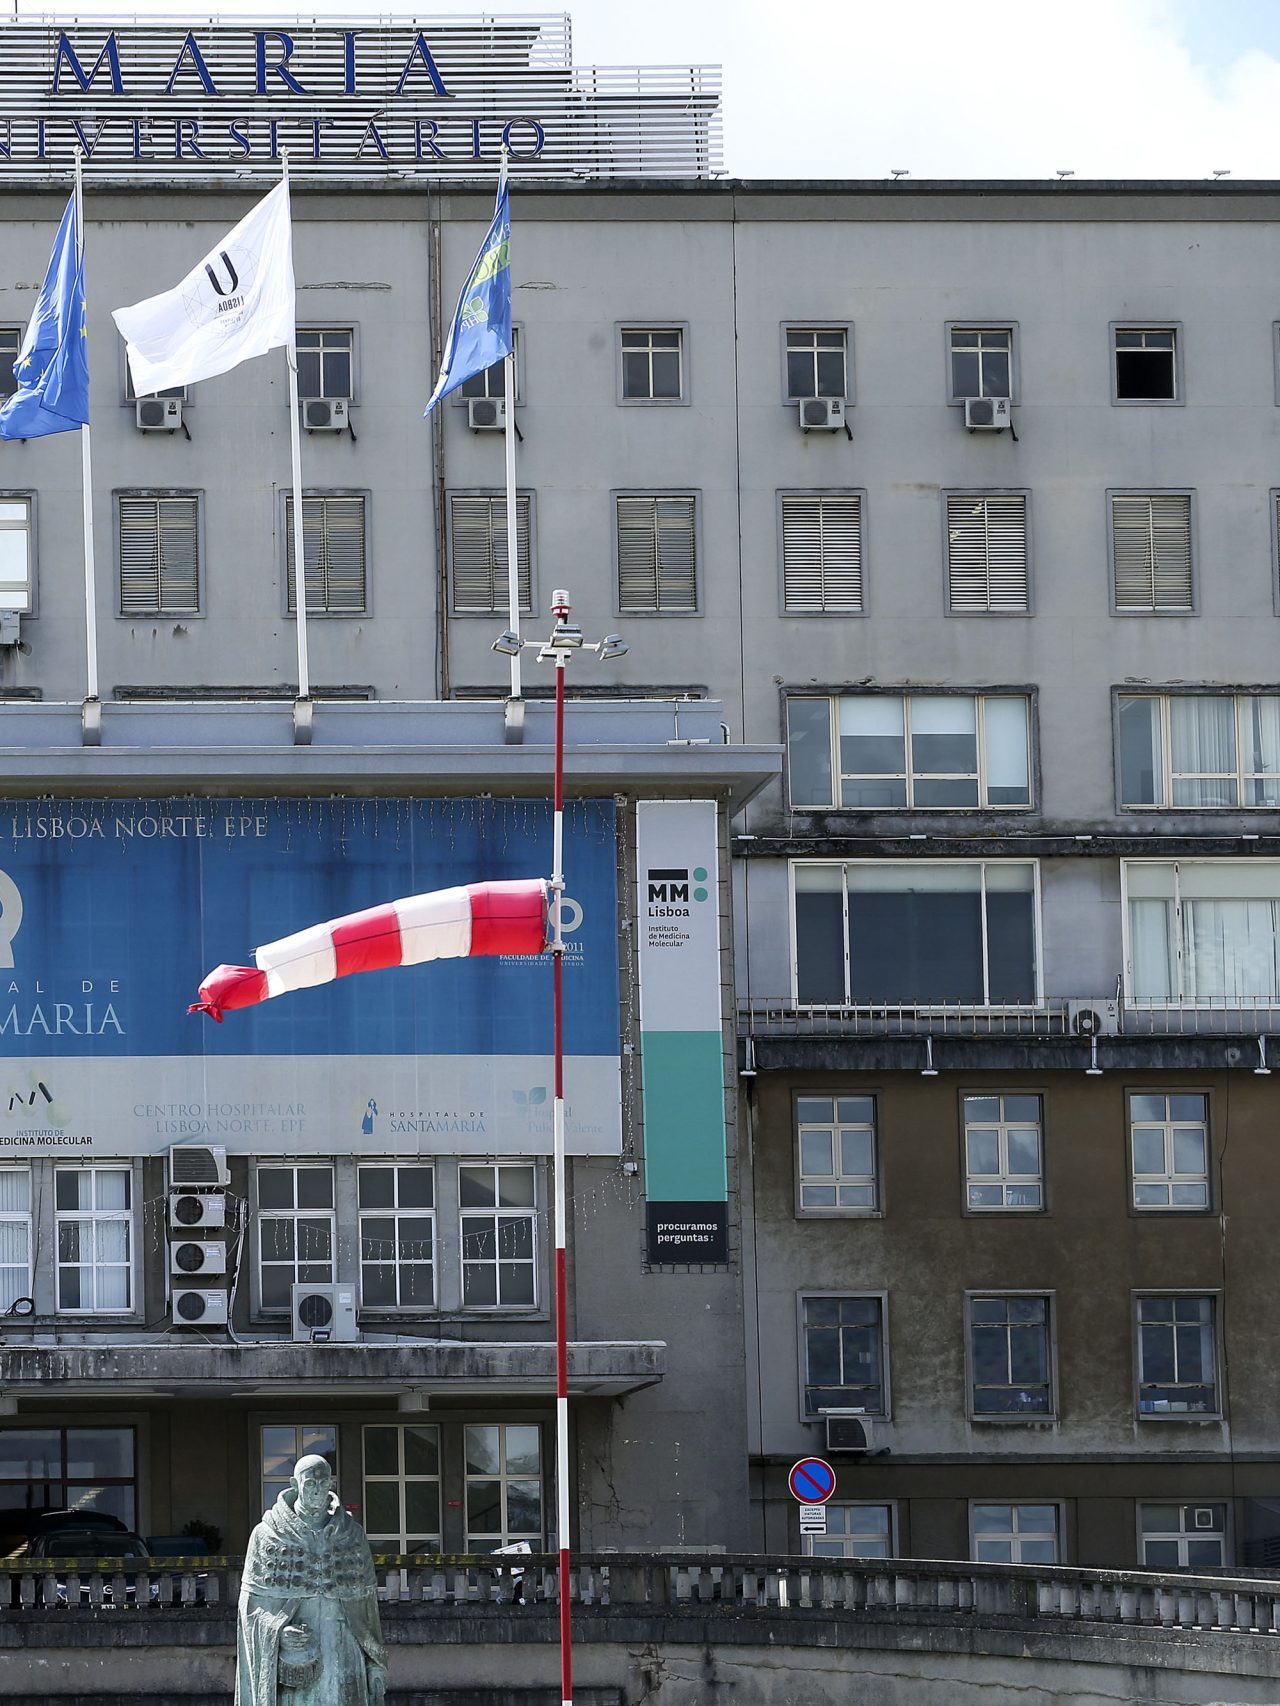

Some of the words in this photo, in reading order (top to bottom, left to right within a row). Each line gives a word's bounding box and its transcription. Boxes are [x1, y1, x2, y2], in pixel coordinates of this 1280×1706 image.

[49, 29, 455, 98] MARIA
[205, 251, 238, 296] U
[11, 817, 106, 839] LISBOA
[224, 816, 268, 838] EPE
[648, 906, 690, 917] Lisboa
[82, 980, 120, 994] DE
[133, 1104, 202, 1118] CENTRO
[207, 1103, 306, 1116] HOSPITALAR
[155, 1119, 211, 1133] LISBOA
[390, 1120, 486, 1133] SANTAMARIA
[36, 1136, 93, 1145] MOLECULAR
[657, 1223, 718, 1233] procuramos
